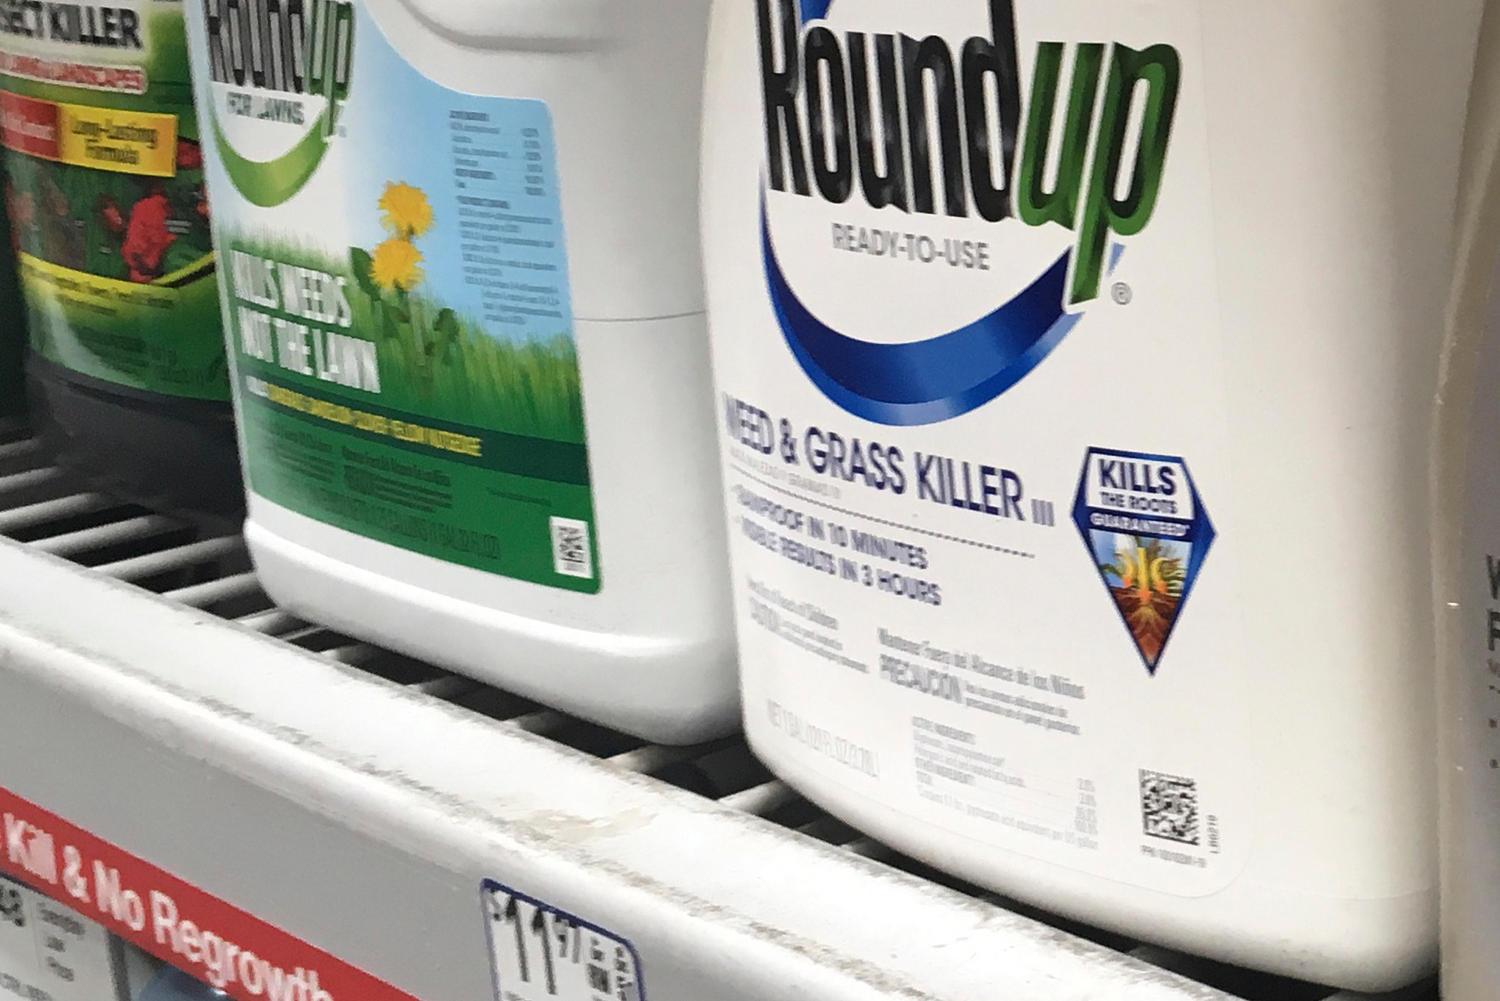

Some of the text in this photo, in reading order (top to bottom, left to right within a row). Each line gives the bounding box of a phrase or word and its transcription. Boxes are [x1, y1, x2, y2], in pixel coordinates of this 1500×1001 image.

[50, 2, 144, 49] KILLER
[832, 222, 990, 271] READY-TO-USE
[779, 417, 800, 465] &
[803, 425, 906, 495] GRASS
[914, 451, 1025, 522] KILLER
[1098, 458, 1177, 496] KILLS
[1100, 491, 1178, 516] THE ROOTS
[3, 812, 58, 886] Kill
[62, 845, 91, 904] &
[92, 859, 146, 932] No
[149, 890, 335, 1001] Regrowth
